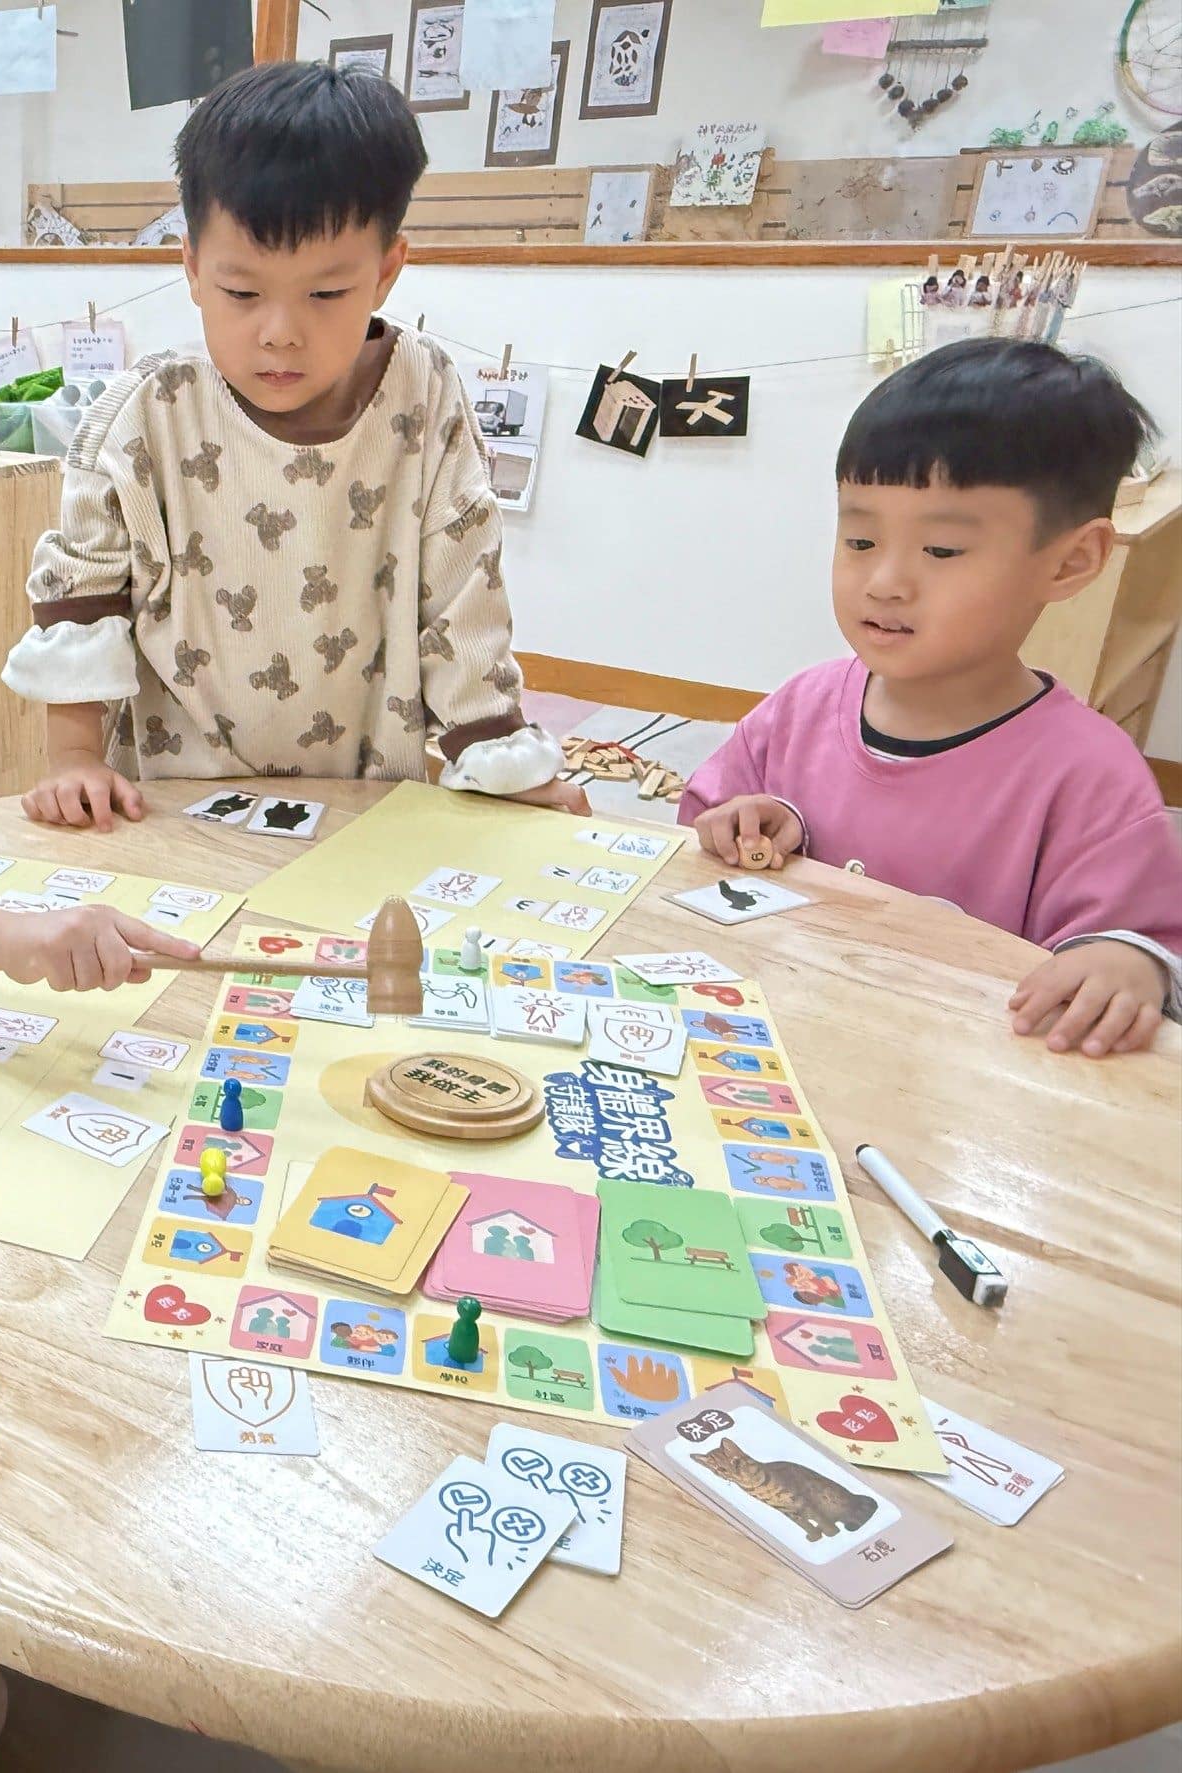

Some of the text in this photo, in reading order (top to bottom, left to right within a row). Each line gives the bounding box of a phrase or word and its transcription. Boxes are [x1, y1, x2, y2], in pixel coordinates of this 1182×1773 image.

[549, 1083, 597, 1136] 守護隊
[586, 1061, 674, 1181] 身體界線
[680, 1411, 732, 1441] 決定
[420, 1555, 467, 1588] 決定
